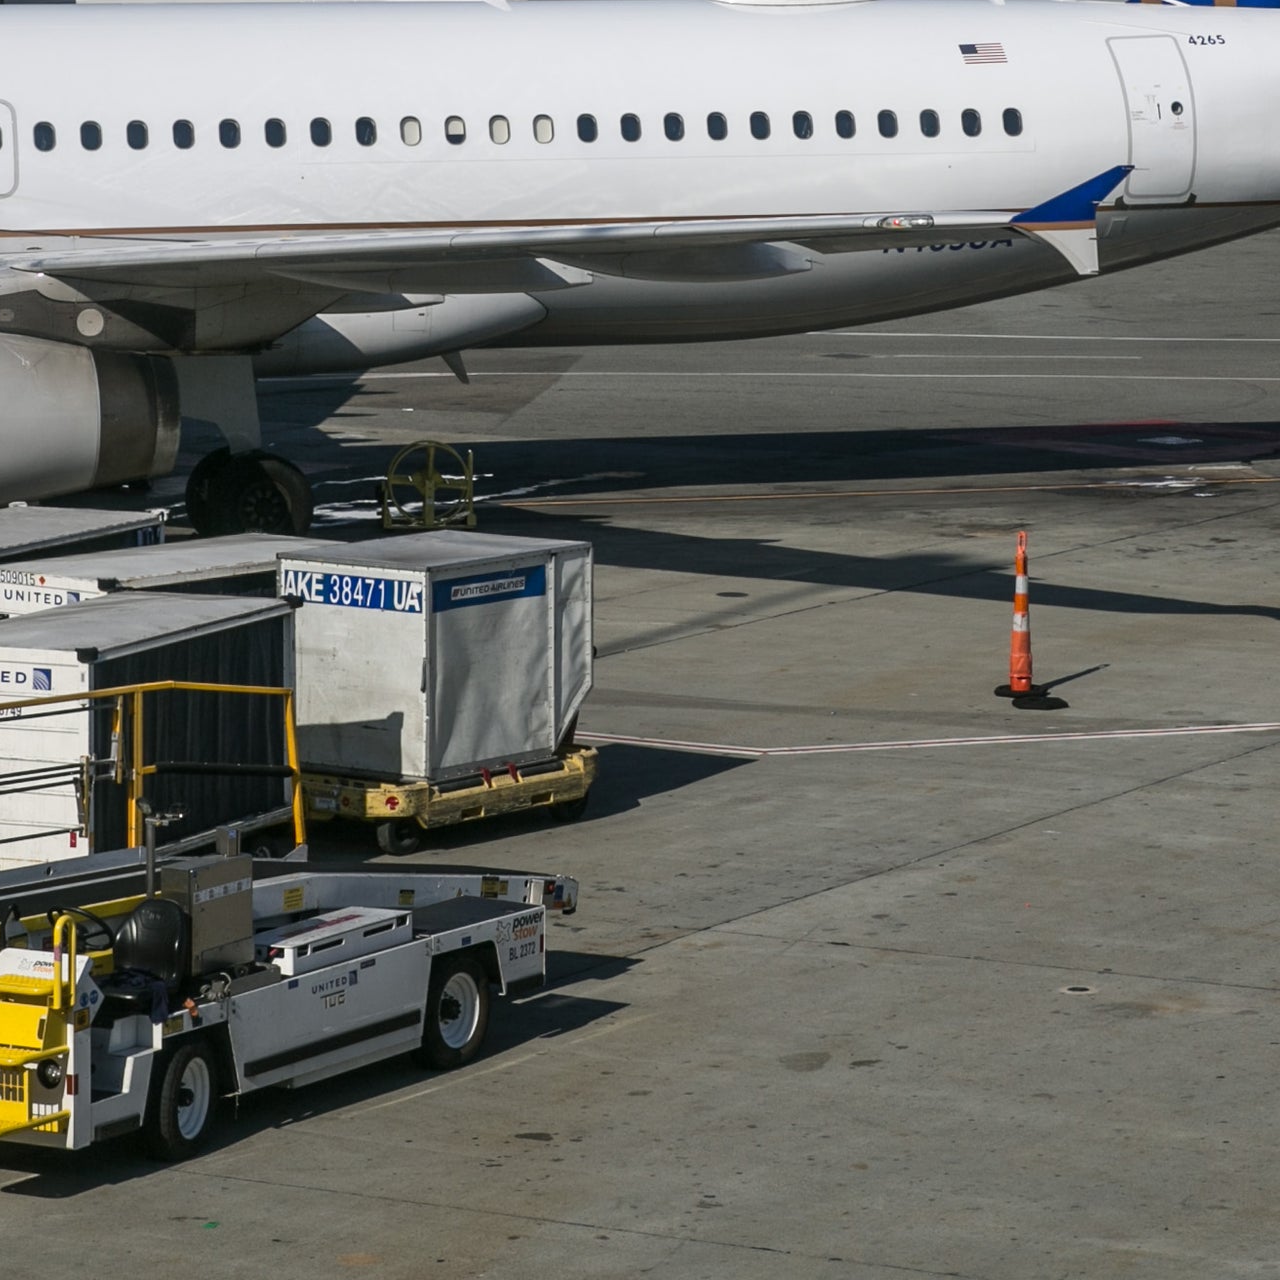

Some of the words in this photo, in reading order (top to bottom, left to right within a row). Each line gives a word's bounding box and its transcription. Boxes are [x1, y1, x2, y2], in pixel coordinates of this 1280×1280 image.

[1188, 34, 1226, 46] 4265
[4, 588, 63, 606] UNITED
[284, 570, 324, 602] AKE
[329, 575, 385, 609] 38471
[393, 581, 422, 612] UA
[460, 585, 490, 597] UNITED
[513, 911, 544, 932] power
[513, 925, 538, 941] stow
[509, 947, 518, 961] BL
[520, 941, 536, 958] 2372
[312, 976, 347, 994] UNITED
